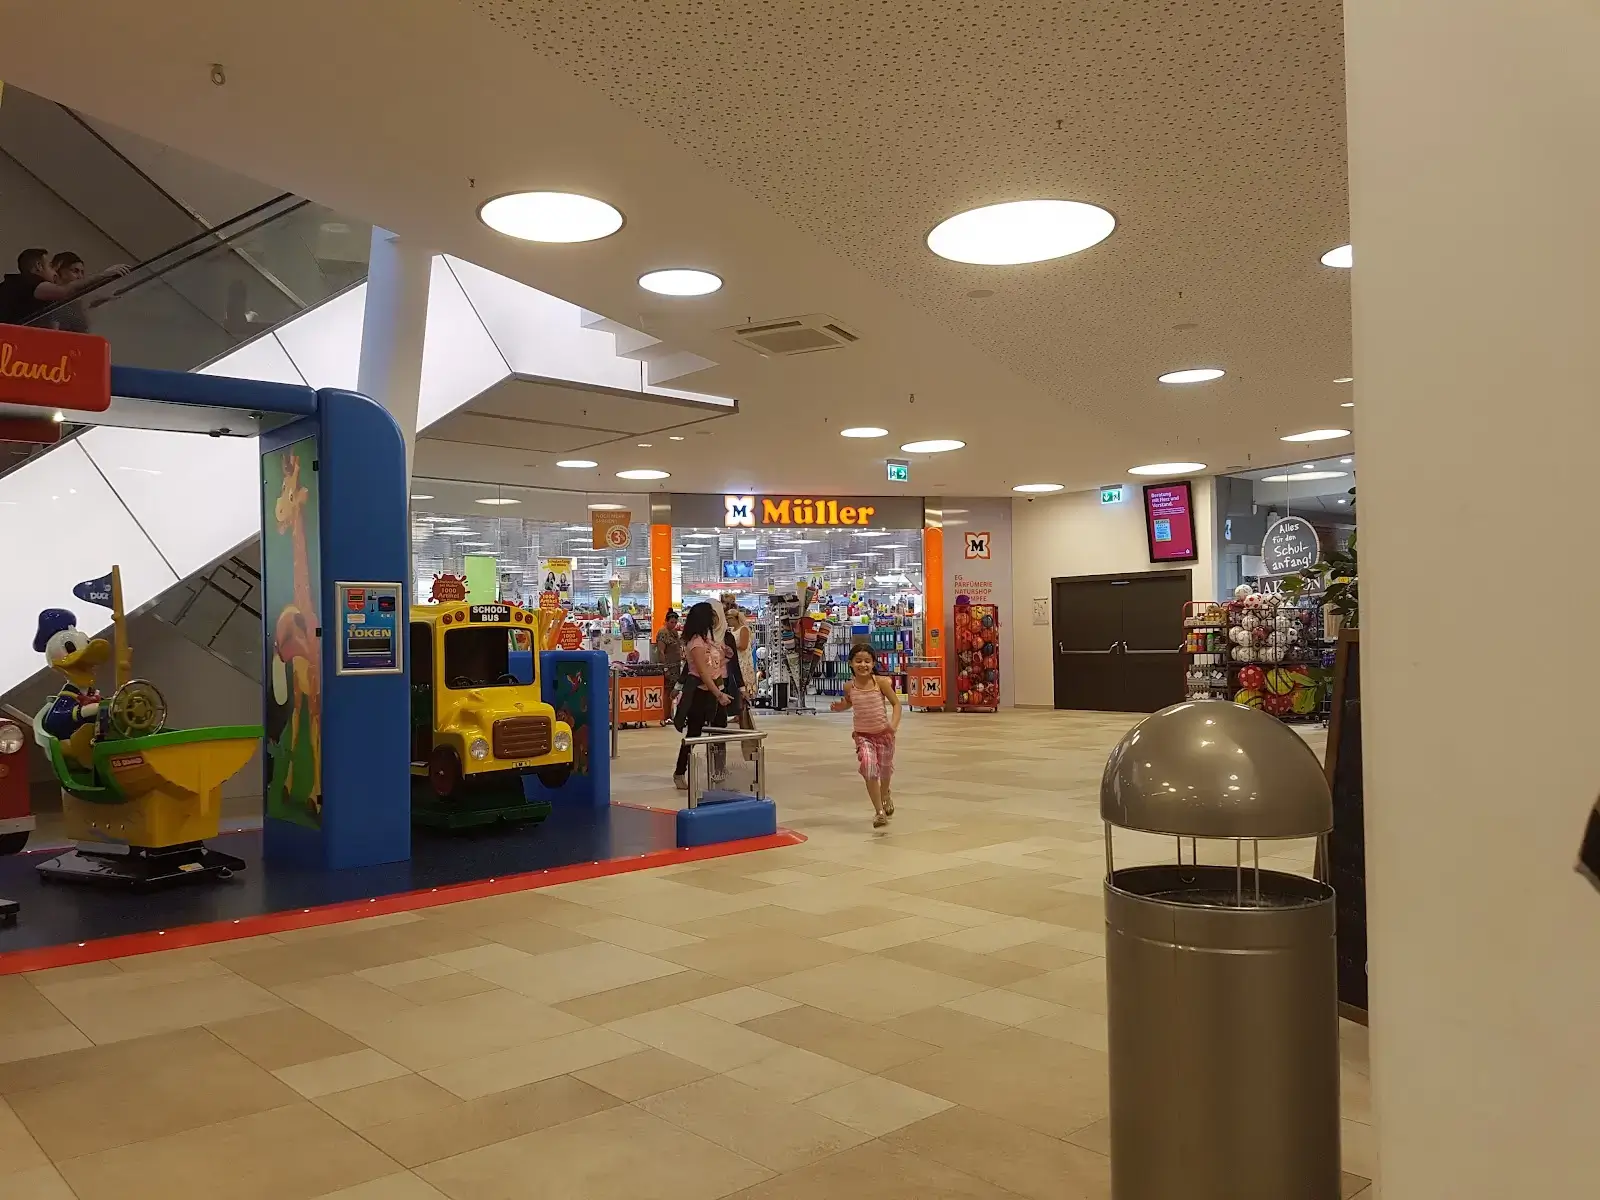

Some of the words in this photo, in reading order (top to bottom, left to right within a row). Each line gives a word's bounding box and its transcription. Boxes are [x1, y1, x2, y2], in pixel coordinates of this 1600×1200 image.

[762, 498, 875, 525] Müller
[1279, 523, 1300, 534] Alles
[1272, 536, 1284, 544] für
[1285, 534, 1297, 542] den
[1274, 541, 1309, 557] Schul-
[1272, 551, 1312, 571] anfang!
[472, 606, 508, 614] SCHOOL
[481, 613, 500, 622] BUS
[347, 629, 391, 638] TOKEN
[624, 694, 635, 704] M
[648, 693, 658, 703] M
